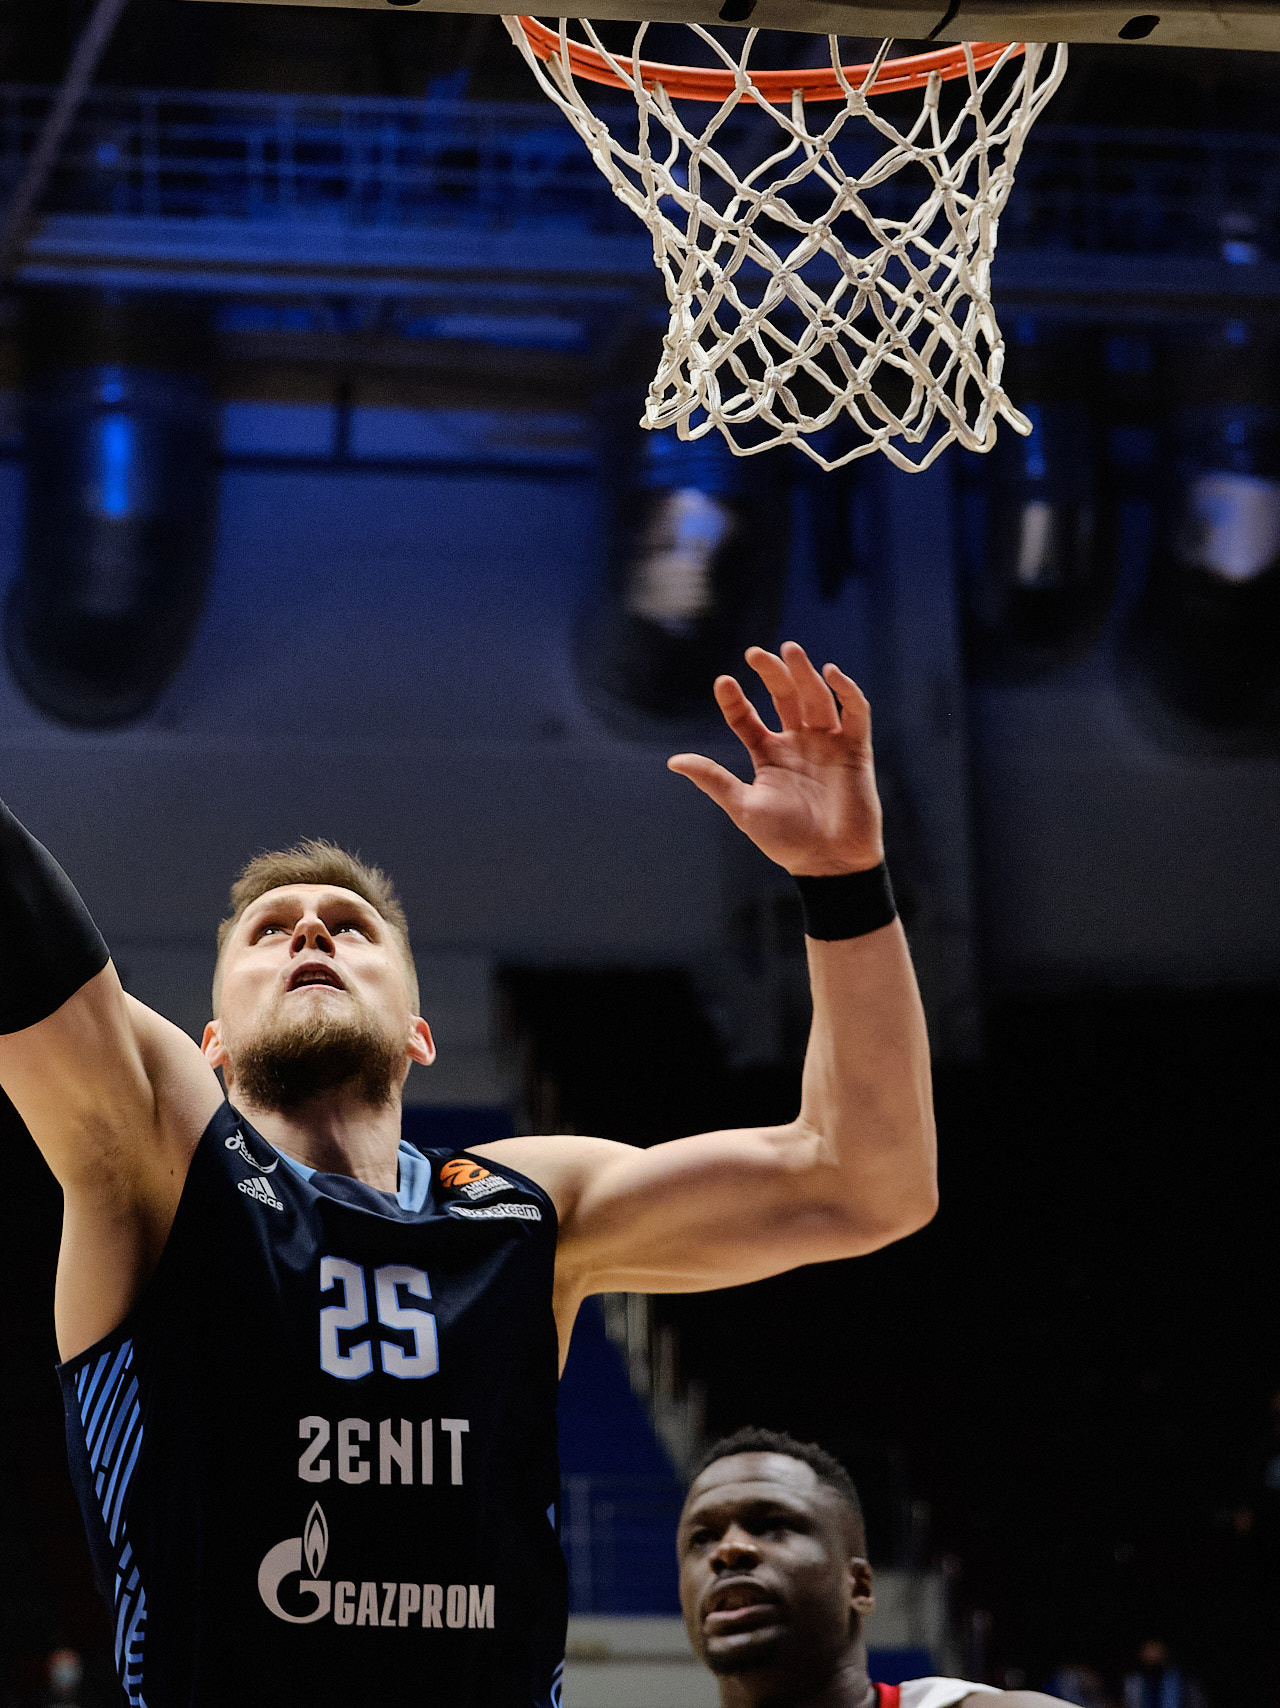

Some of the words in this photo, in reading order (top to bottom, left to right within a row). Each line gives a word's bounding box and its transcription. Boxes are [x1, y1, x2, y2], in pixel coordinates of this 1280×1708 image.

[237, 1181, 284, 1212] adidas
[320, 1255, 440, 1380] 25
[298, 1415, 470, 1486] ZENIT
[334, 1581, 496, 1629] GAZPROM
